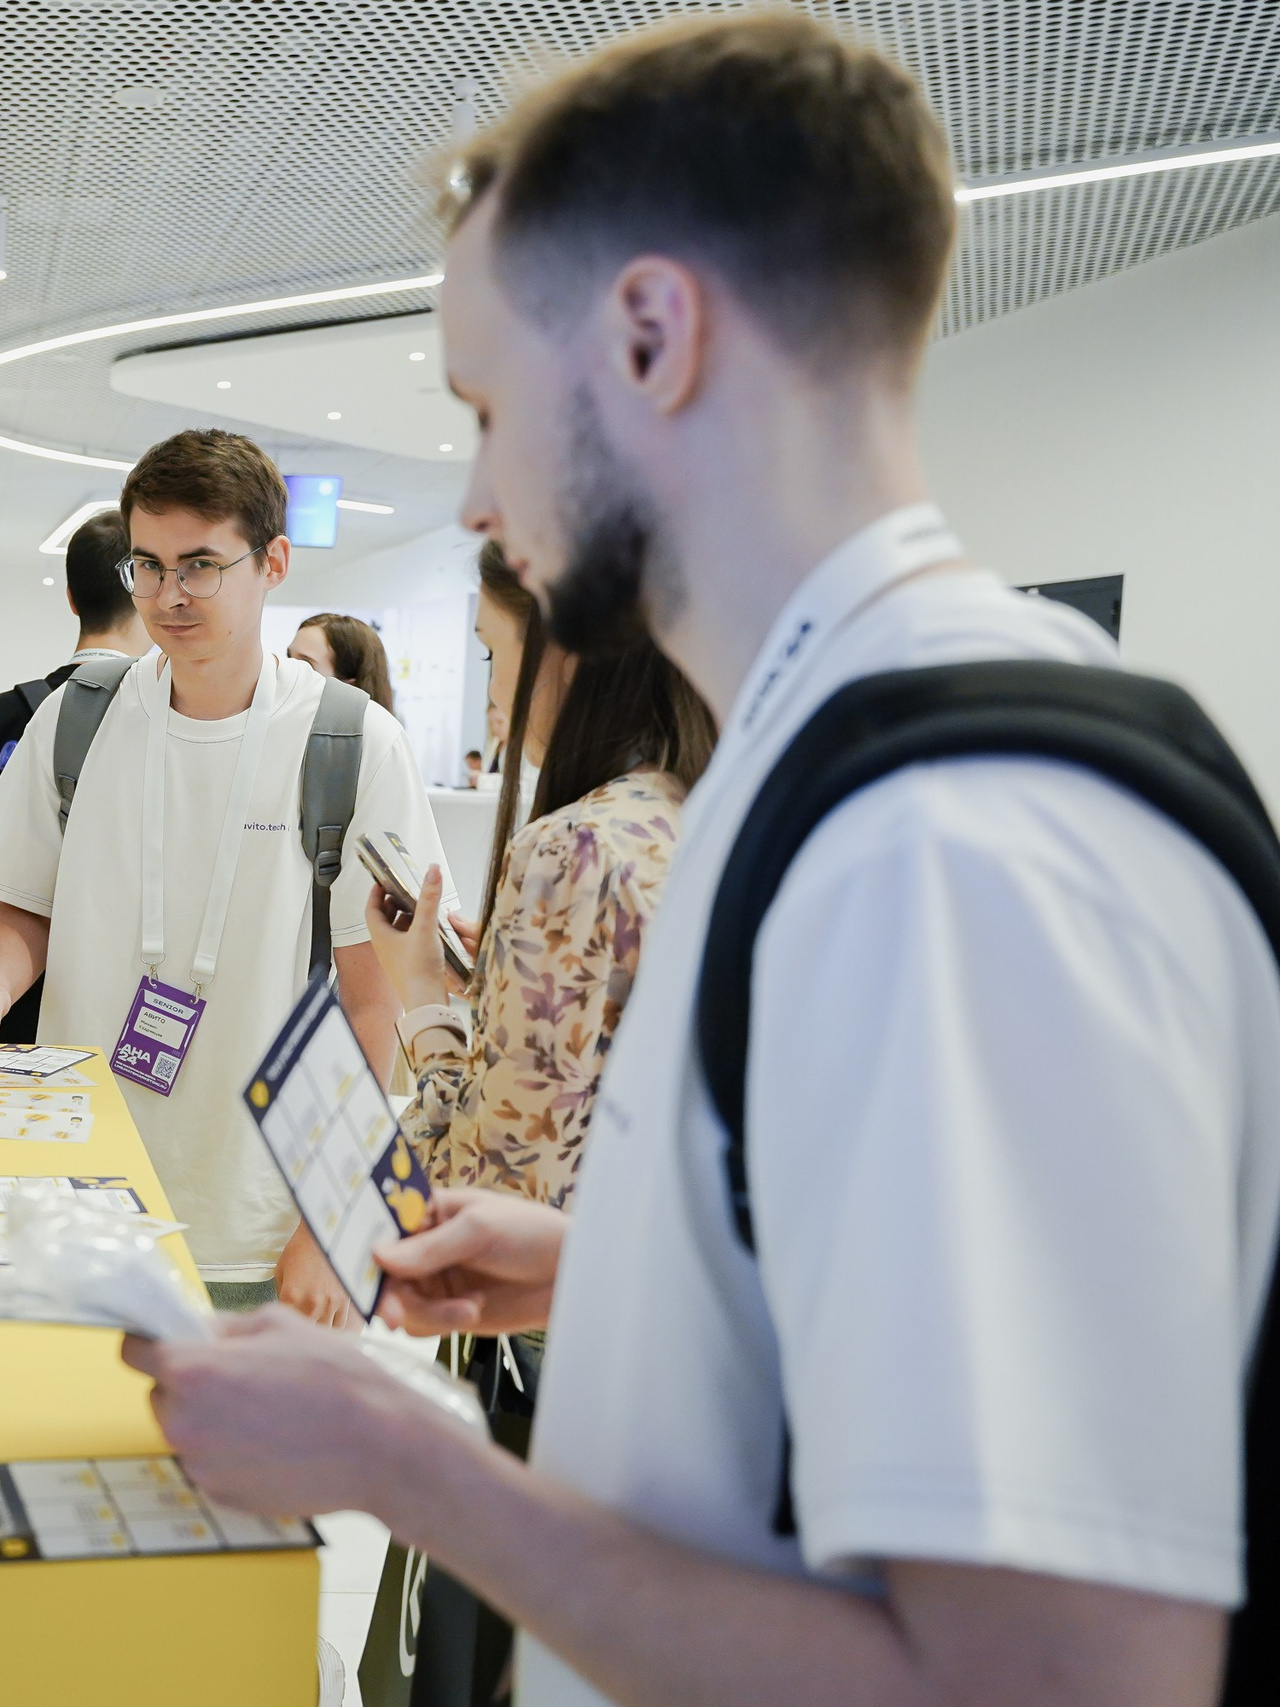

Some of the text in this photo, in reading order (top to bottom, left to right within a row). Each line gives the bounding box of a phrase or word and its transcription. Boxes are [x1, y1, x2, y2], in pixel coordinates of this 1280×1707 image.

[153, 998, 184, 1015] SENIOR
[144, 1011, 166, 1024] АВИТО
[118, 1051, 137, 1065] 24
[120, 1043, 151, 1063] AHA
